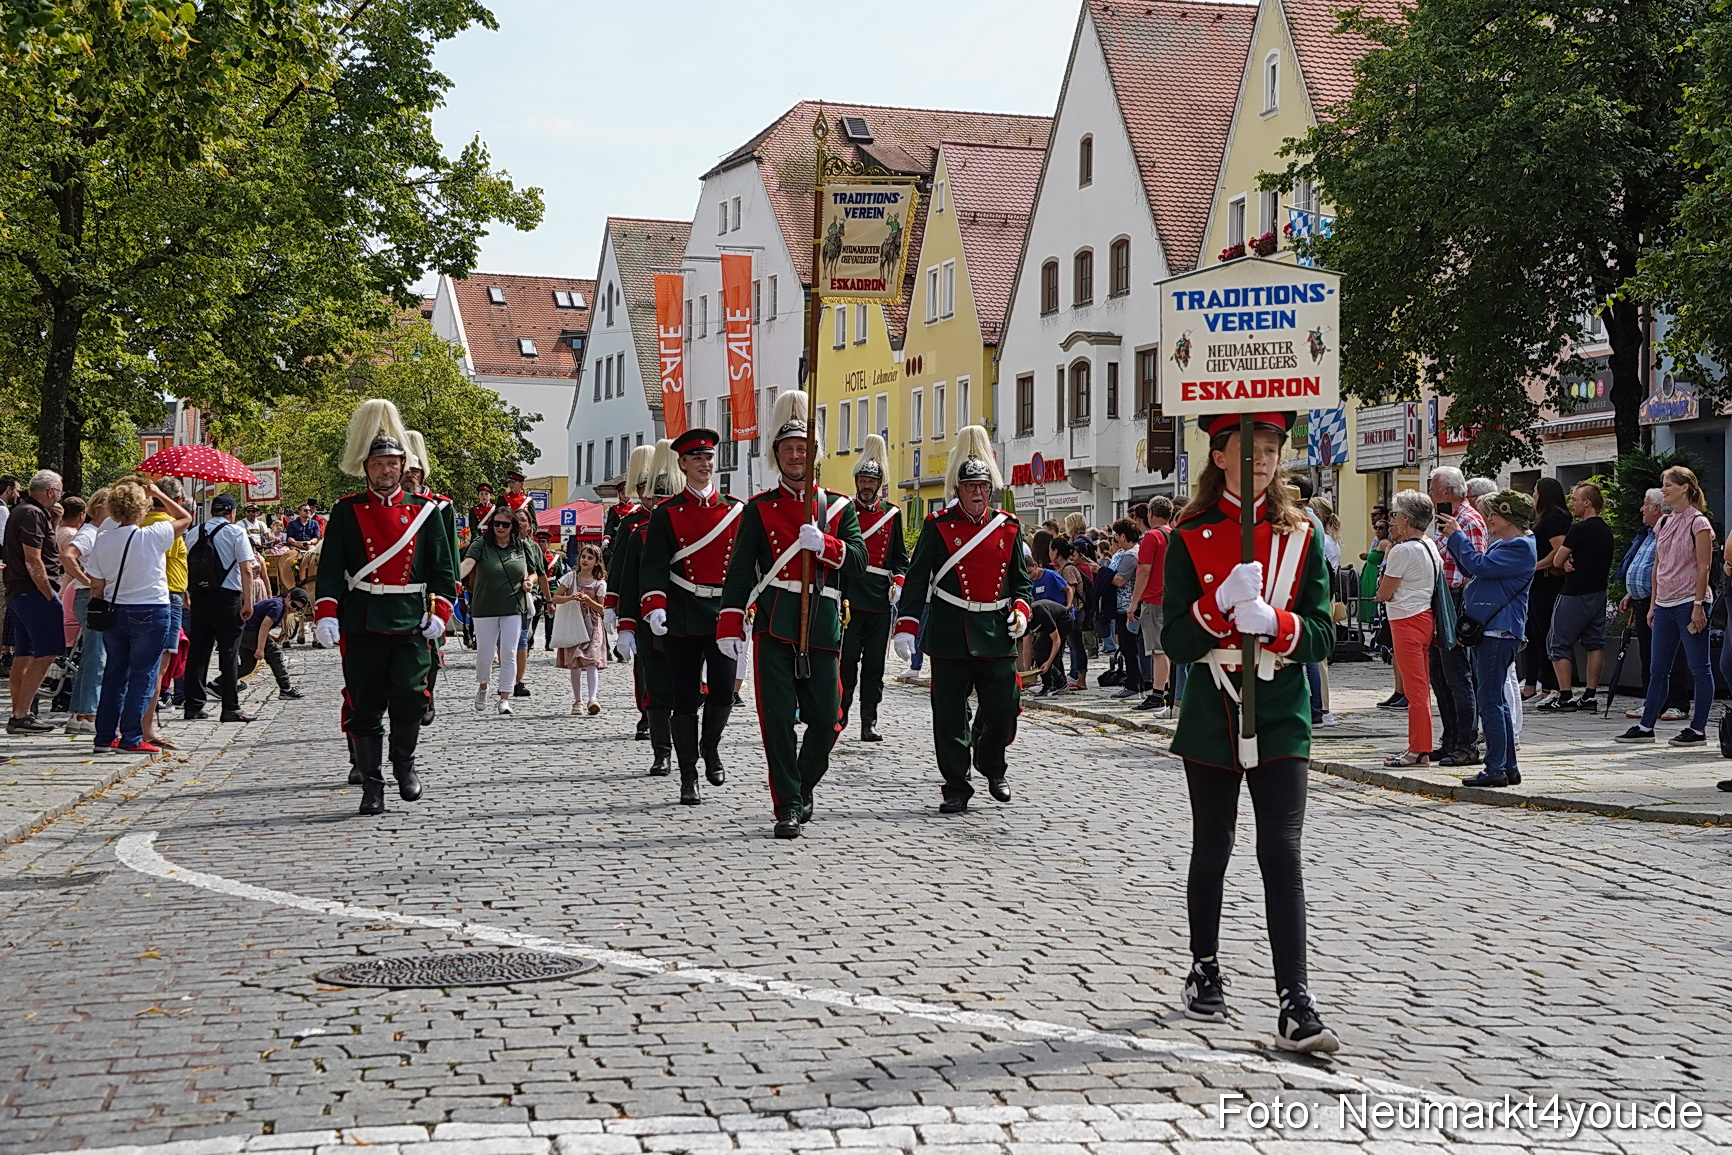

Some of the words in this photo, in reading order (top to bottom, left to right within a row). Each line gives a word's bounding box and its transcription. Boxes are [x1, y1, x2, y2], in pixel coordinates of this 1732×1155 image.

[832, 192, 904, 205] TRADITIONS-
[844, 206, 885, 219] VEREIN
[841, 245, 880, 255] NEUMARKTER
[830, 278, 887, 292] ESKADRON
[1171, 283, 1335, 311] TRADITIONS-
[1202, 310, 1297, 333] VEREIN
[726, 307, 752, 382] SALE
[1207, 341, 1294, 358] NEUMARKTER
[1206, 355, 1298, 373] CHEVAULEGERS
[845, 370, 867, 392] HOTEL
[1181, 376, 1321, 401] ESKADRON
[1364, 431, 1382, 444] RIALTO
[1383, 429, 1397, 442] KINO
[1407, 403, 1416, 463] KINO
[564, 511, 573, 524] P
